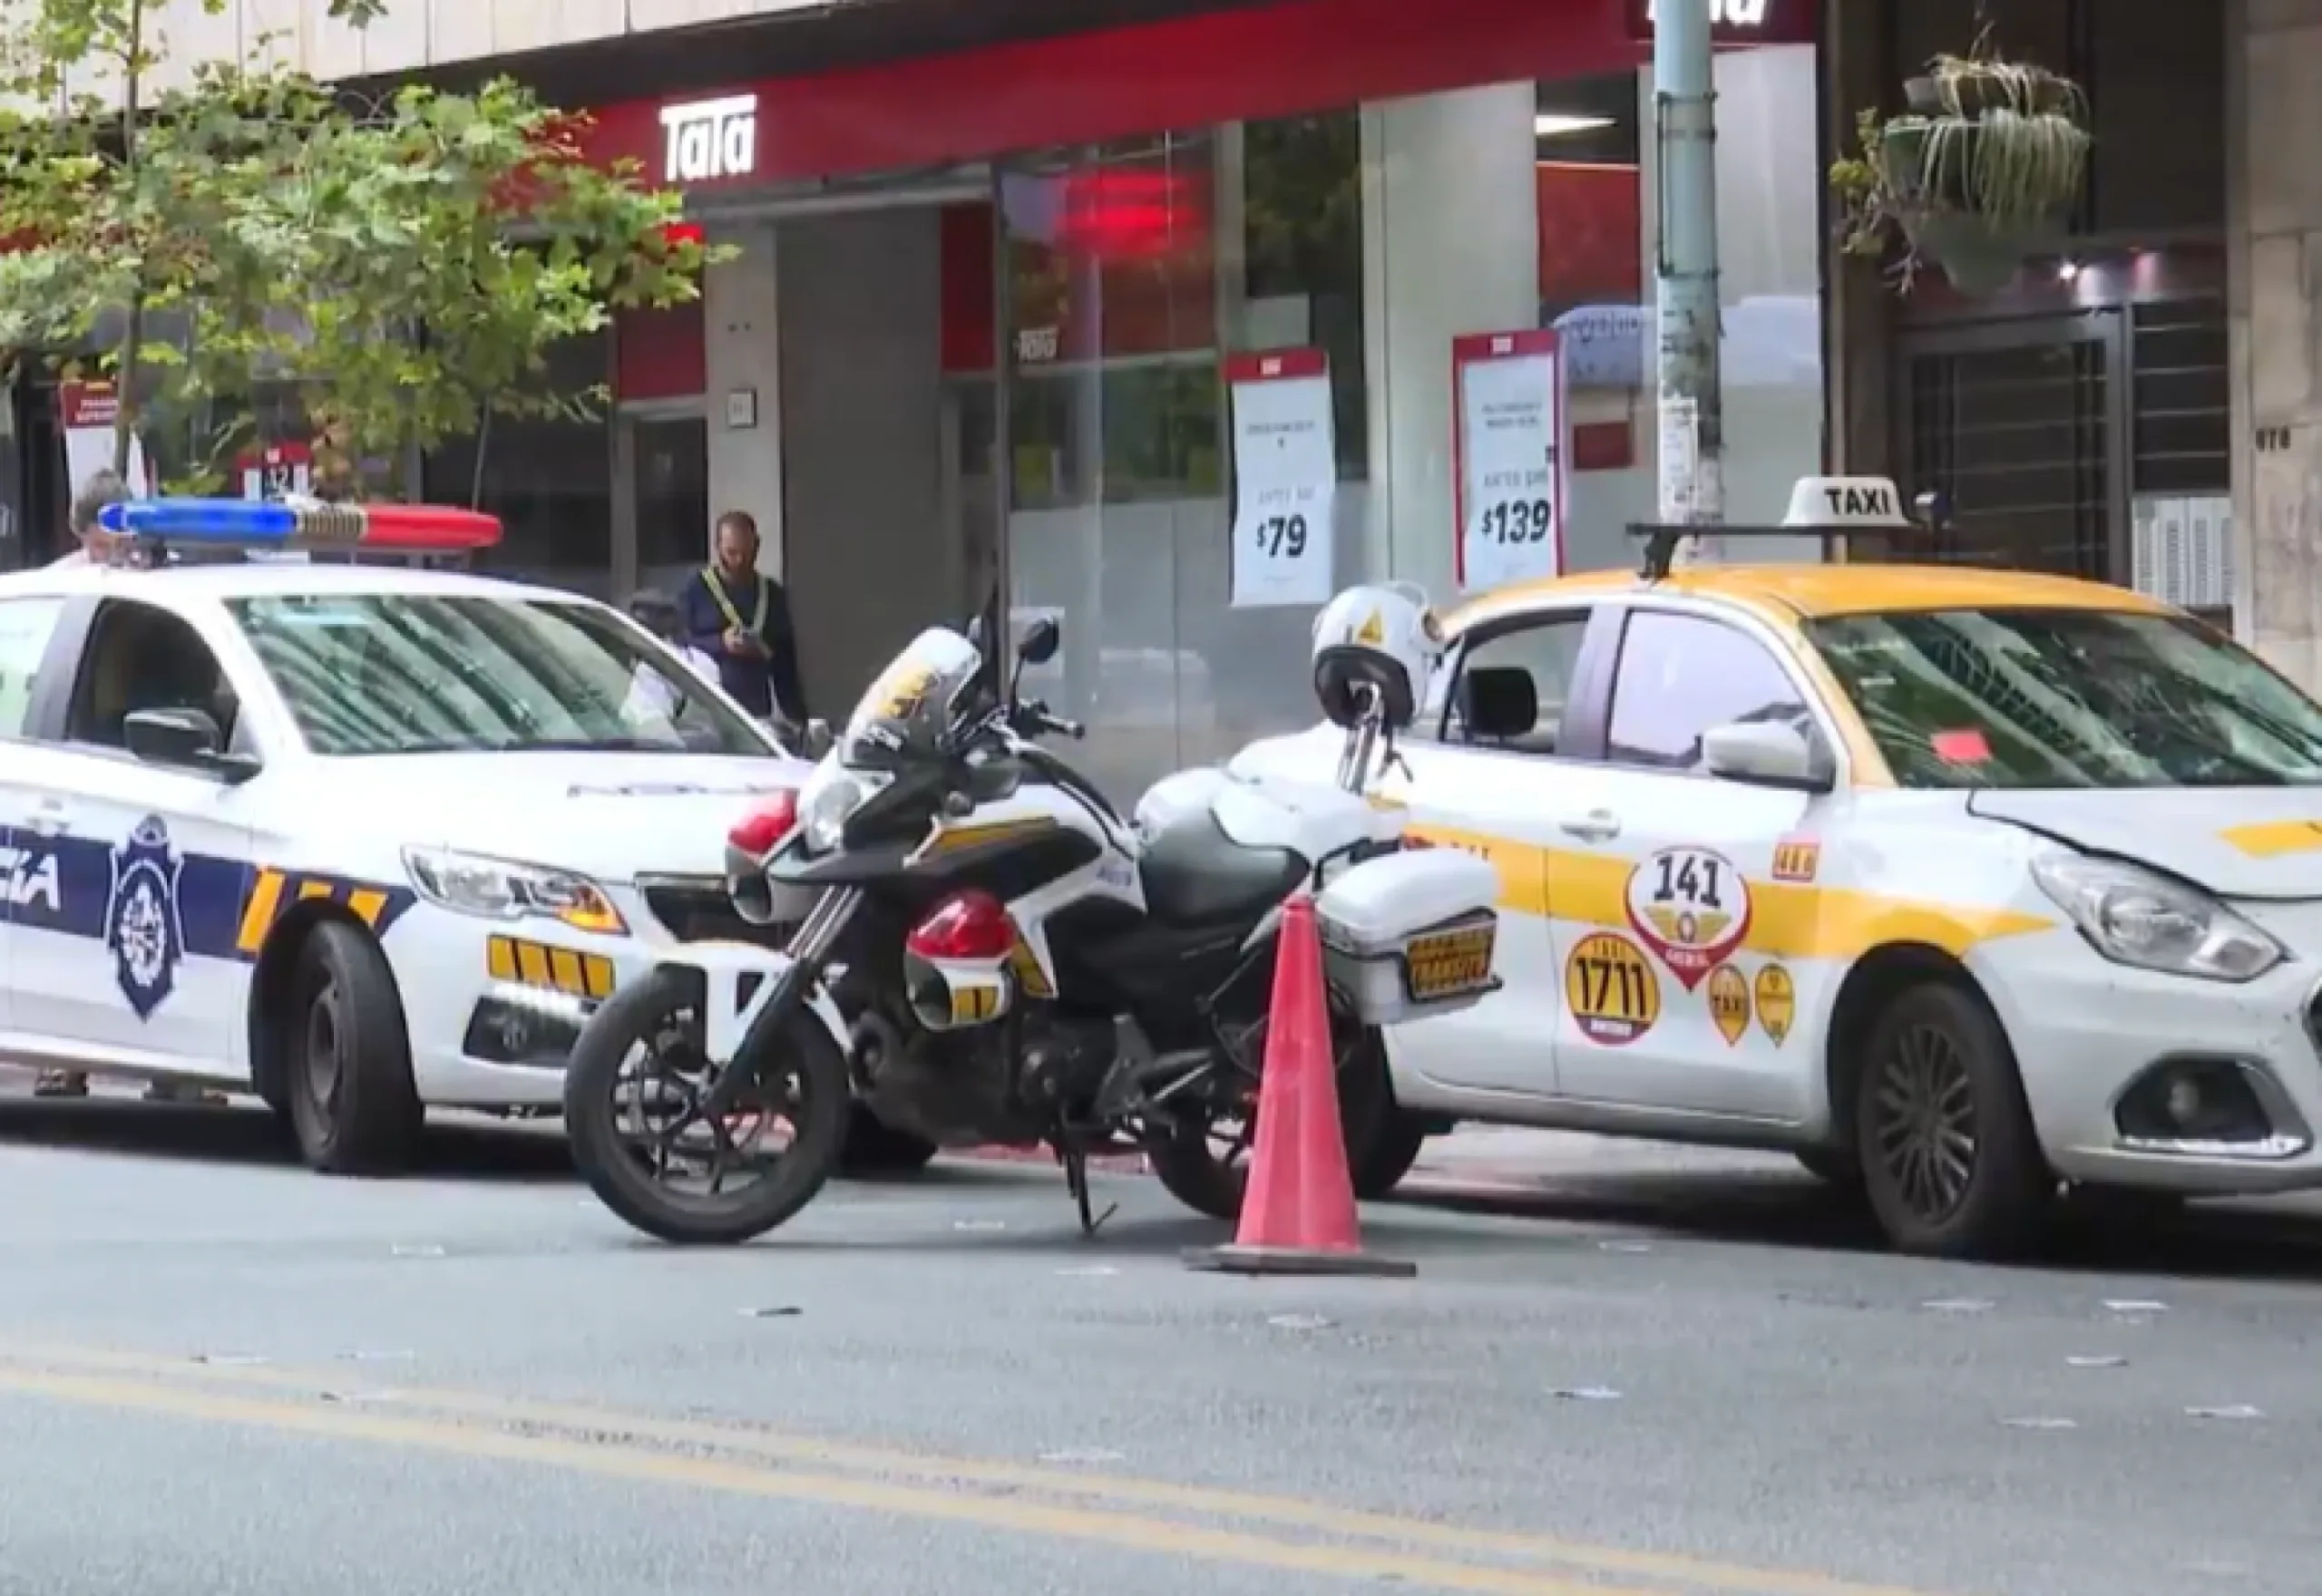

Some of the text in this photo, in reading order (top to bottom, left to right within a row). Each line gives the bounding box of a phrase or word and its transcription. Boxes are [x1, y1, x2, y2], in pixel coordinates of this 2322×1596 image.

[659, 94, 757, 181] TaTa
[1481, 500, 1551, 545] $139
[1824, 486, 1891, 515] TAXI
[1256, 514, 1307, 559] $79
[1654, 855, 1722, 909] 141
[1576, 957, 1646, 1017] 1711
